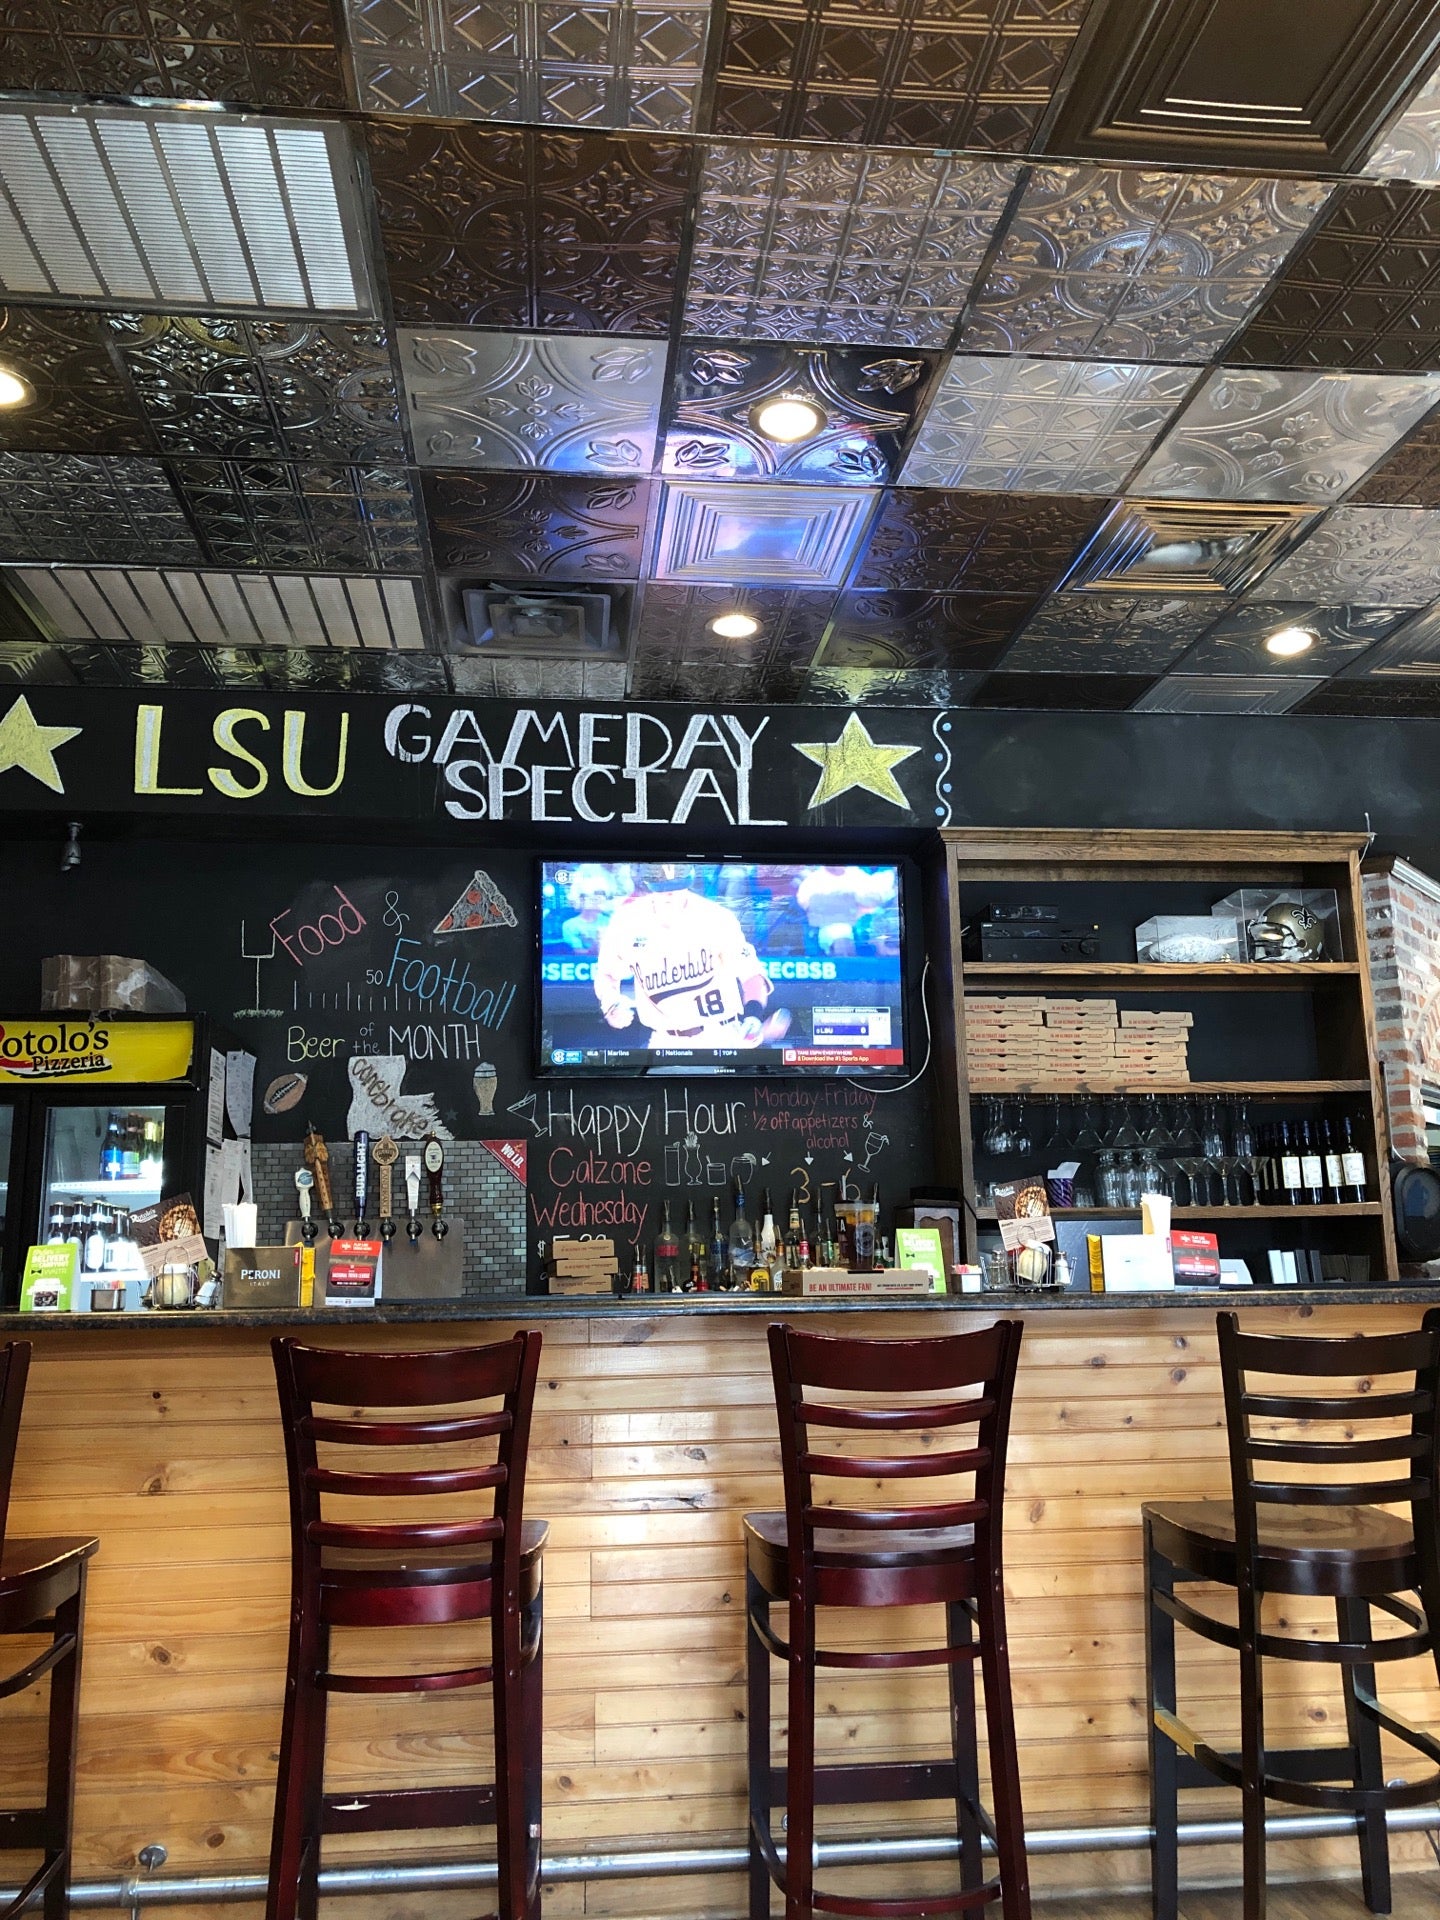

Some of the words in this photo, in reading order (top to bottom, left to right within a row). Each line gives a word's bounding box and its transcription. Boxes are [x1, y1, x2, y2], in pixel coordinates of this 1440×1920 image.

[134, 704, 349, 798] LSU
[384, 703, 770, 772] GAMEDAY
[444, 759, 788, 826] SPECIAL
[269, 885, 367, 966] Food
[383, 890, 410, 936] &
[365, 969, 384, 985] 50
[386, 938, 517, 1030] Football
[693, 990, 724, 1016] 18
[0, 1022, 109, 1058] otolo's
[287, 1025, 346, 1062] Beer
[359, 1022, 375, 1036] of
[389, 1023, 481, 1061] MONTH
[32, 1051, 105, 1072] Pizzeria
[352, 1039, 381, 1055] the
[548, 1088, 651, 1157] Happy
[770, 1111, 790, 1130] off
[791, 1113, 858, 1136] appetizers
[862, 1113, 874, 1129] &
[806, 1132, 849, 1149] alcohol
[356, 1141, 366, 1174] LIGHT
[549, 1146, 651, 1188] Calzone
[356, 1173, 366, 1198] BUD
[530, 1190, 648, 1245] Wednesday
[241, 1269, 281, 1280] PERONI
[809, 1284, 816, 1292] BE
[818, 1283, 828, 1292] AN
[828, 1283, 856, 1291] ULTIMATE
[858, 1283, 872, 1291] FAN!
